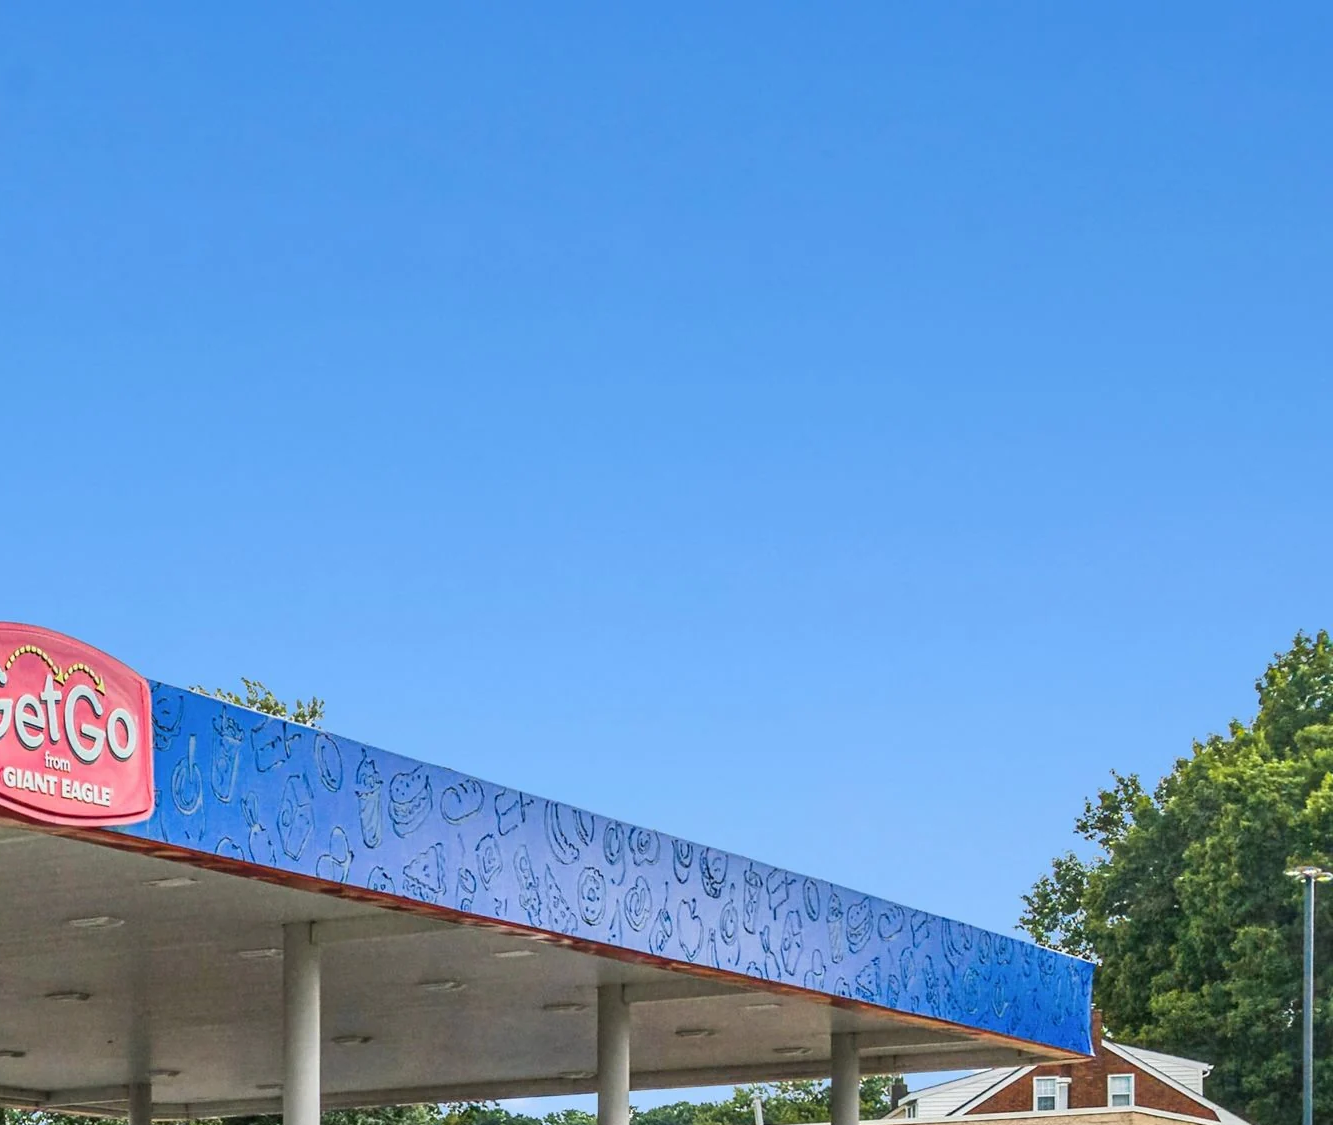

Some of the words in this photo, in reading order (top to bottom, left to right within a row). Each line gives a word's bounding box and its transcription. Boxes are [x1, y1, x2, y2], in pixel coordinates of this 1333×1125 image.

[45, 751, 71, 772] from
[3, 766, 58, 796] GIANT
[61, 779, 111, 807] EAGLE
